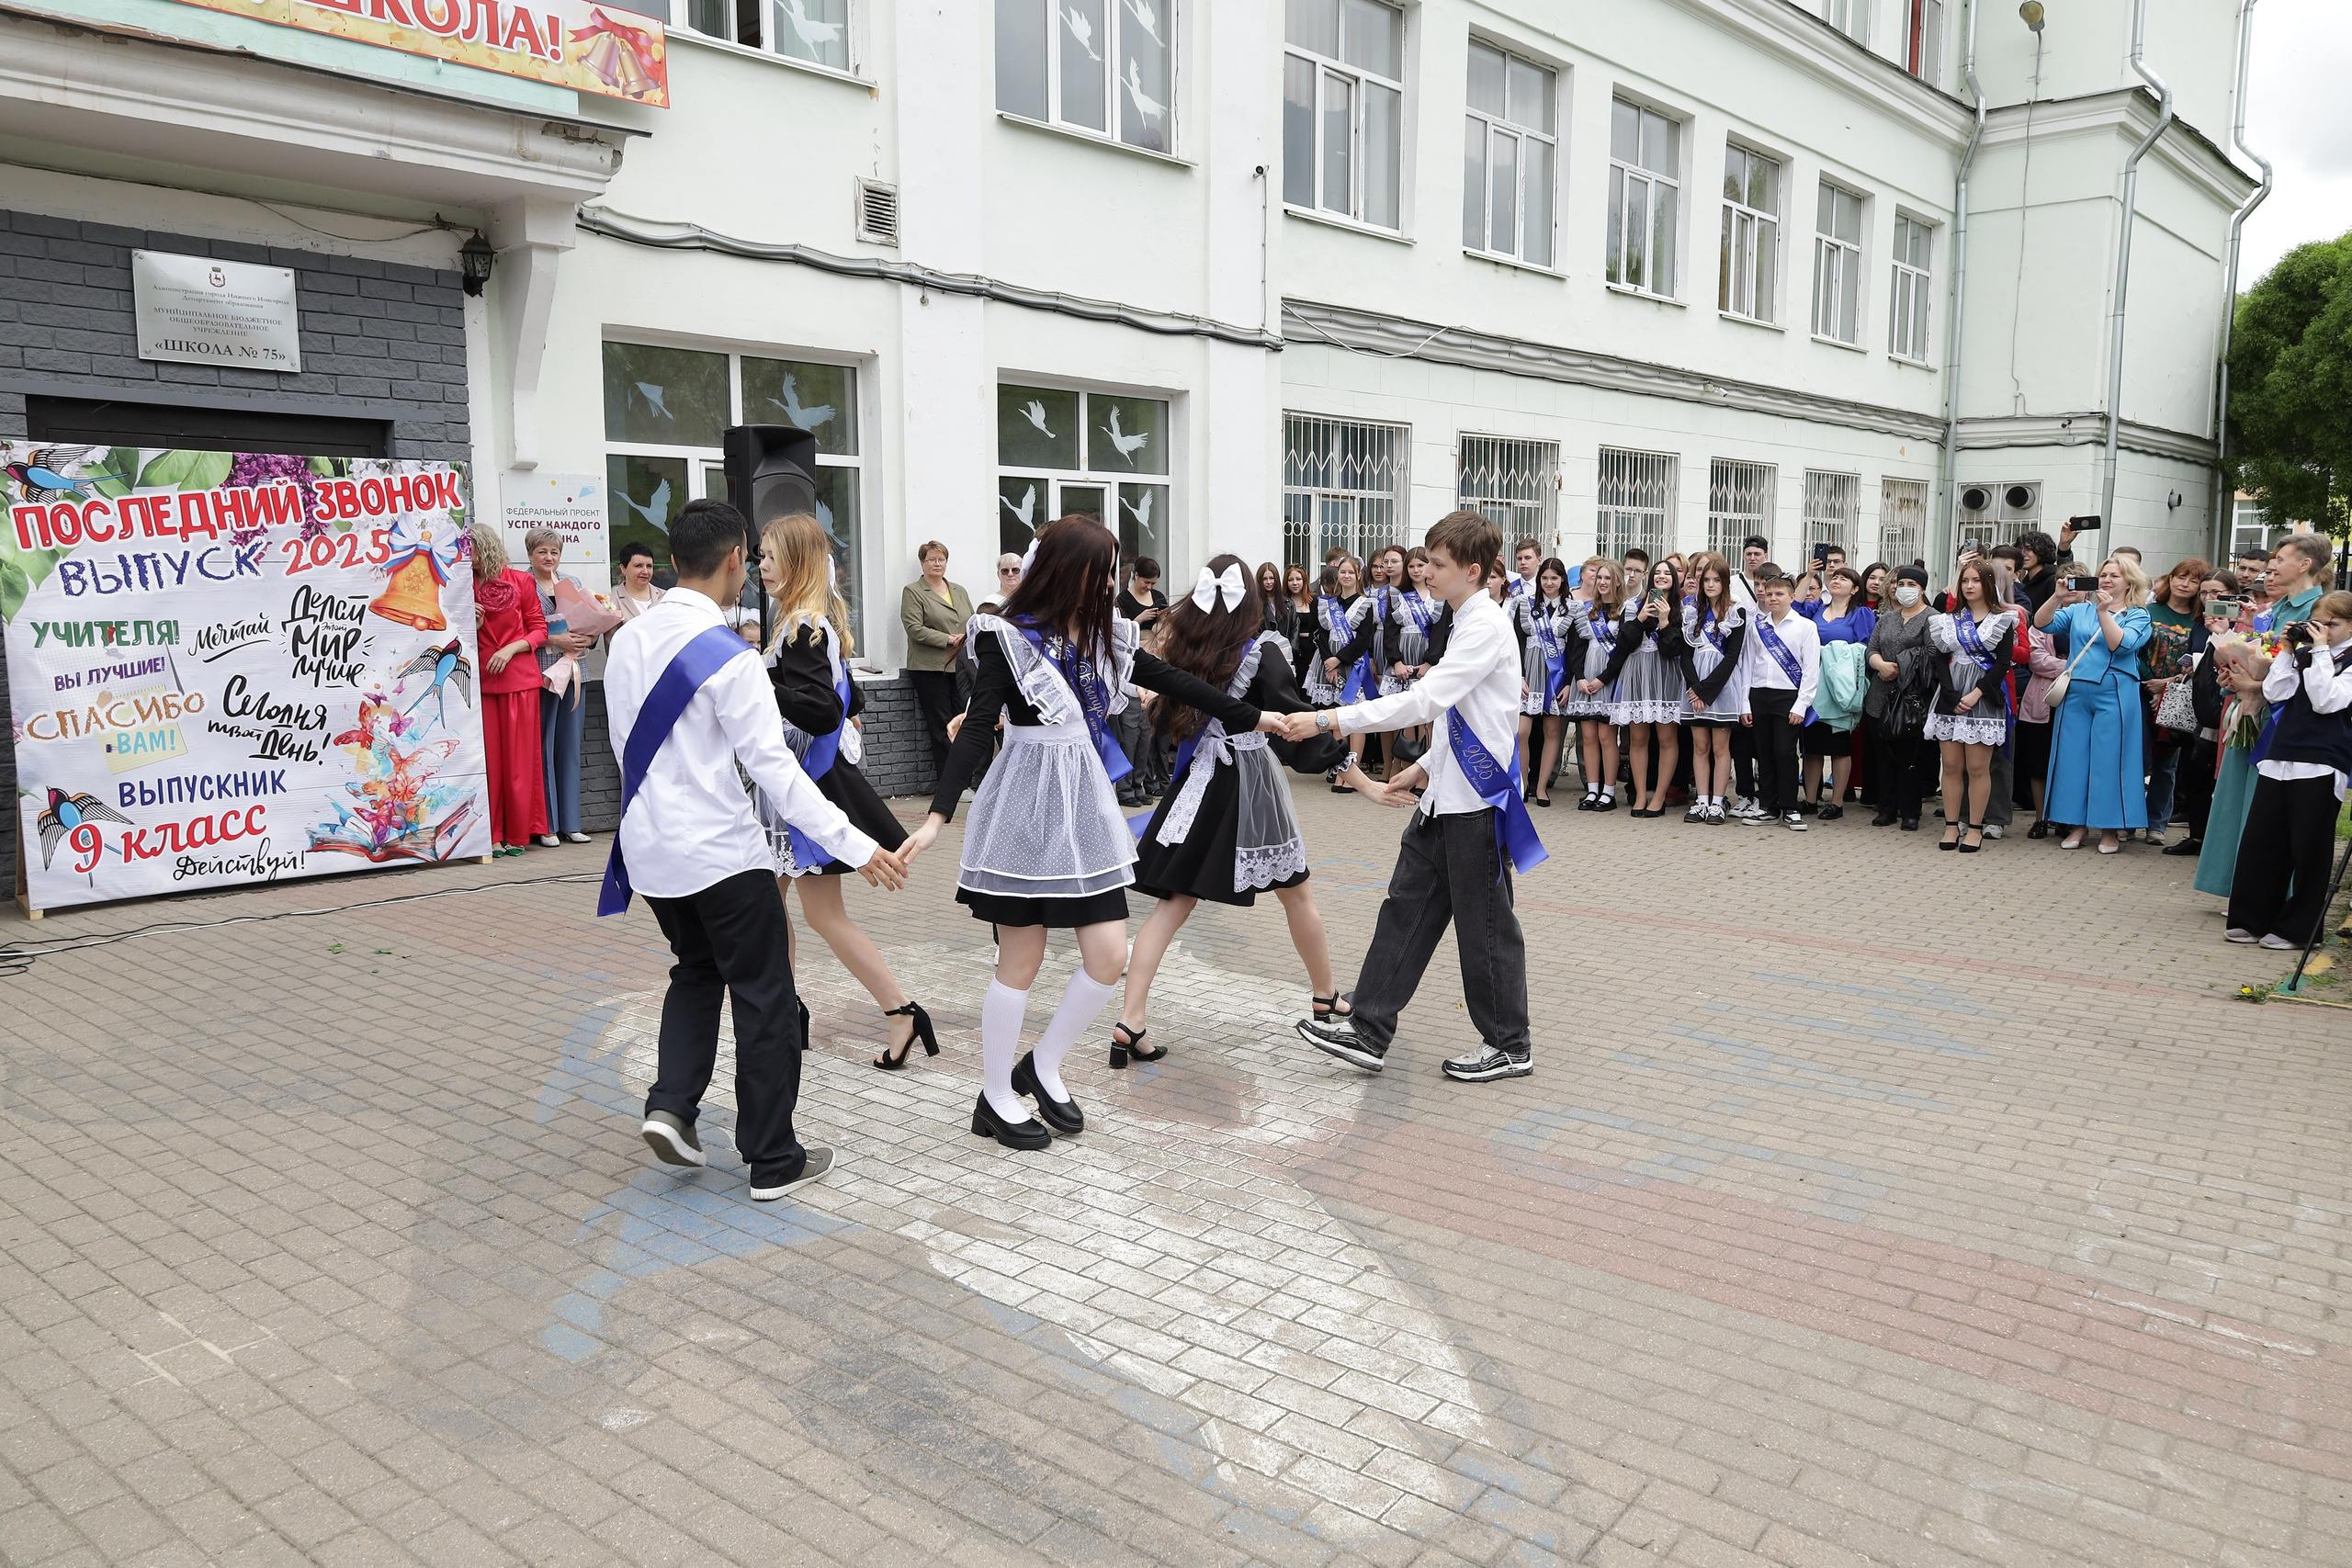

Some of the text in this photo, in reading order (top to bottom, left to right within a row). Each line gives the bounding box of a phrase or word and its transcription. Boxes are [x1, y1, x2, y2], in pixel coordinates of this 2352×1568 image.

[154, 307, 283, 325] МУНИЦИПАЛЬНОЕ БЮДЖЕТНОЕ
[169, 316, 269, 332] ОБЩЕОБРАЗОВАТЕЛЬНОЕ
[193, 326, 248, 337] УЧРЕЖДЕНИЕ
[155, 338, 286, 360] «ШКОЛА № 75»
[13, 472, 462, 549] ПОСЛЕДНИЙ ЗВОНОК
[505, 507, 600, 517] ФЕДЕРАЛЬНЫЙ ПРОЕКТ
[546, 520, 601, 531] КАЖДОГО
[59, 529, 392, 597] ВЫПУСК 2025
[281, 584, 369, 633] Делай
[30, 620, 180, 648] УЧИТЕЛЯ!
[187, 612, 274, 657] Мечтай
[54, 656, 165, 691] ВЫ ЛУЧШИЕ!
[27, 692, 206, 740] СПАСИБО
[223, 674, 327, 729] Сегодня
[117, 729, 175, 754] ВАМ!
[208, 719, 264, 742] твой
[1462, 745, 1499, 779] 2025
[119, 769, 287, 808] ВЫПУСКНИК
[70, 805, 266, 874] 9 класс
[173, 837, 305, 881] Действуй!
